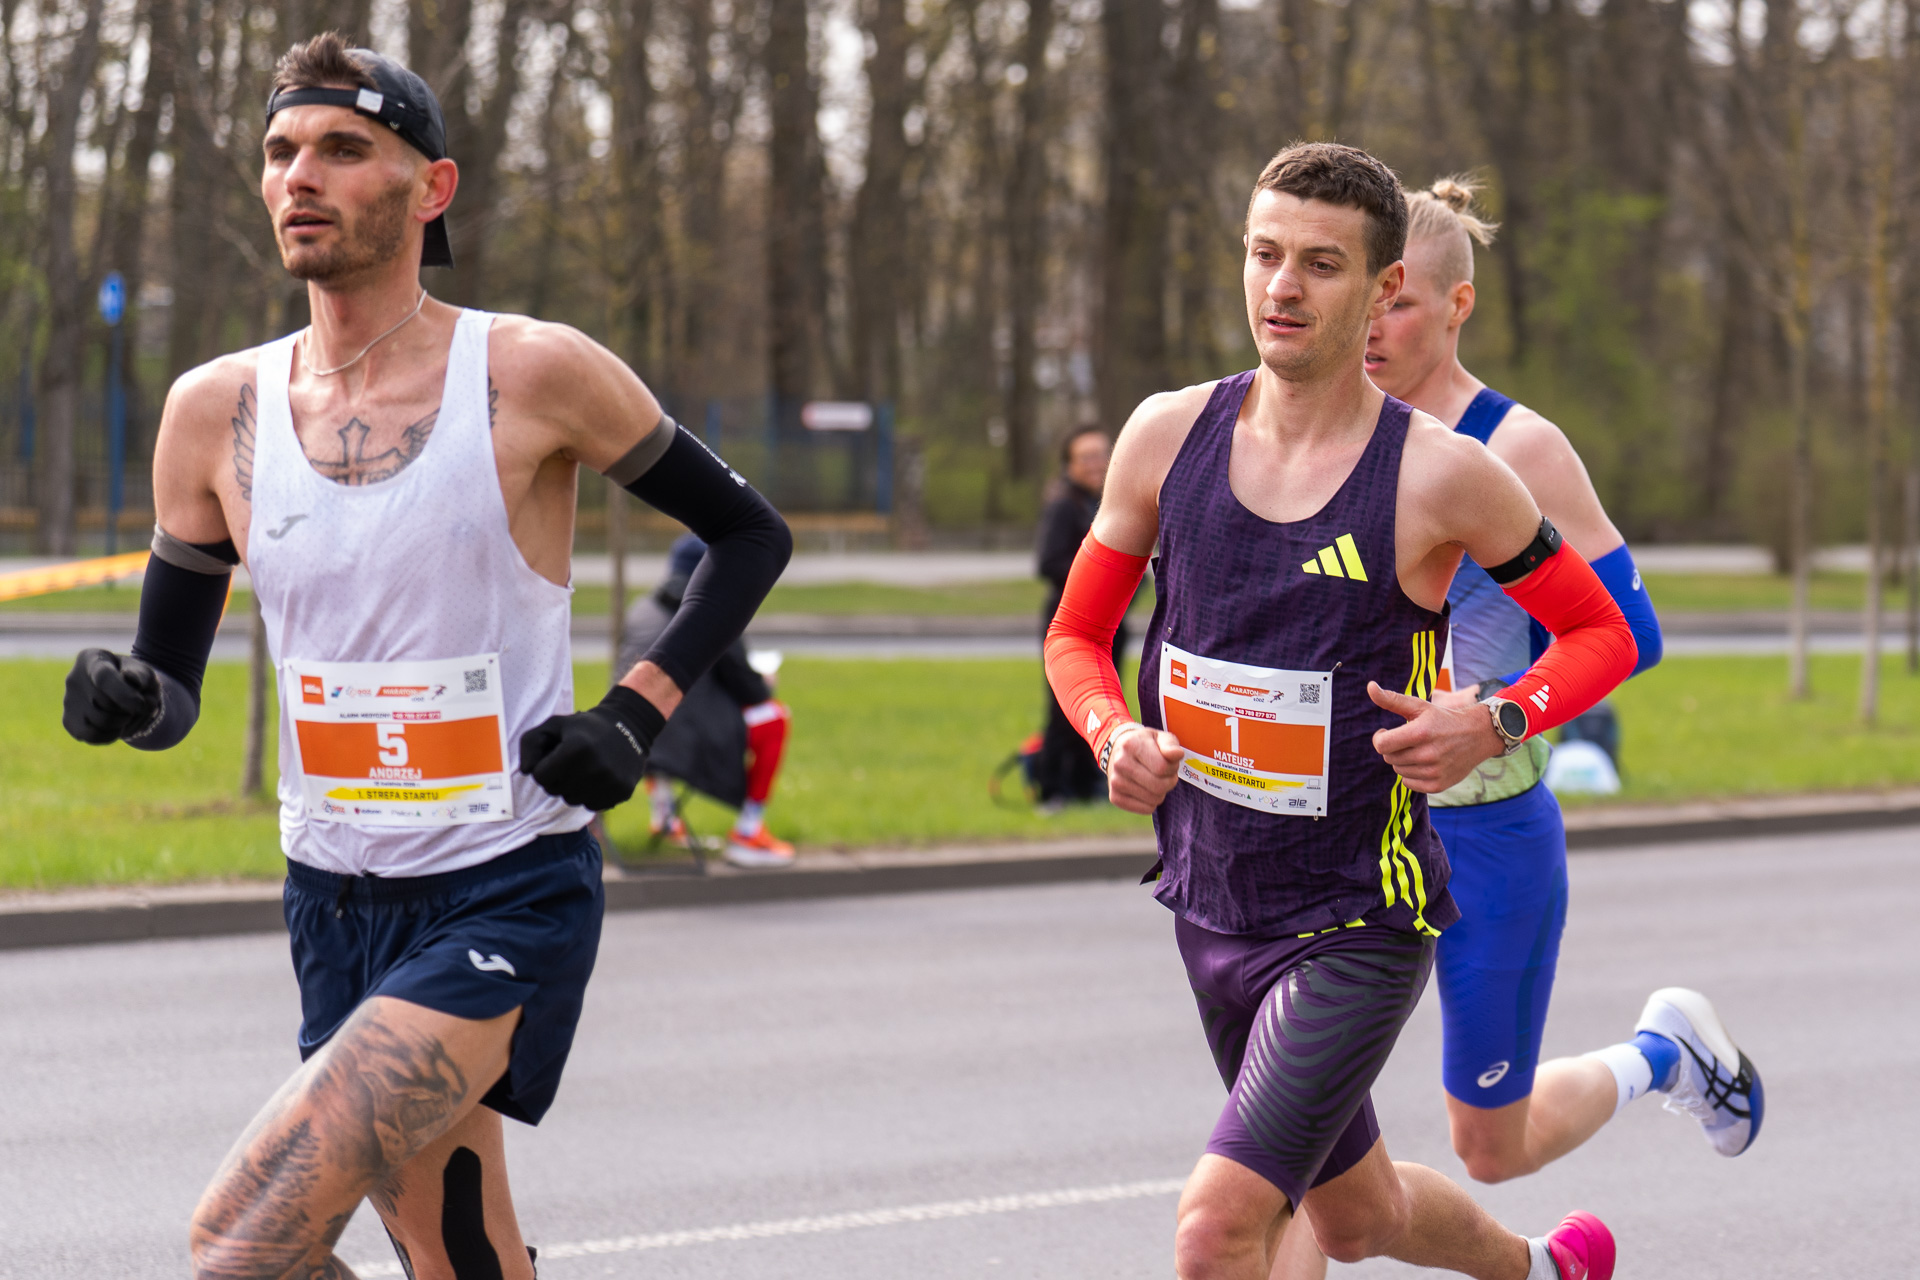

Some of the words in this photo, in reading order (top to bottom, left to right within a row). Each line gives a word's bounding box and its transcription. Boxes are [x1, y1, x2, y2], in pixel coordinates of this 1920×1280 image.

[1230, 686, 1258, 696] MARATON
[1196, 699, 1210, 707] ALARM
[1225, 716, 1239, 754] 1
[376, 723, 409, 767] 5
[1213, 749, 1255, 769] MATEUSZ
[369, 767, 422, 780] ANDRZEJ
[1205, 766, 1211, 774] 1.
[1211, 768, 1237, 782] STREFA
[1238, 775, 1266, 789] STARTU
[357, 790, 364, 799] 1.
[366, 791, 401, 800] STREFA
[402, 791, 439, 800] STARTU
[1288, 798, 1307, 807] ale
